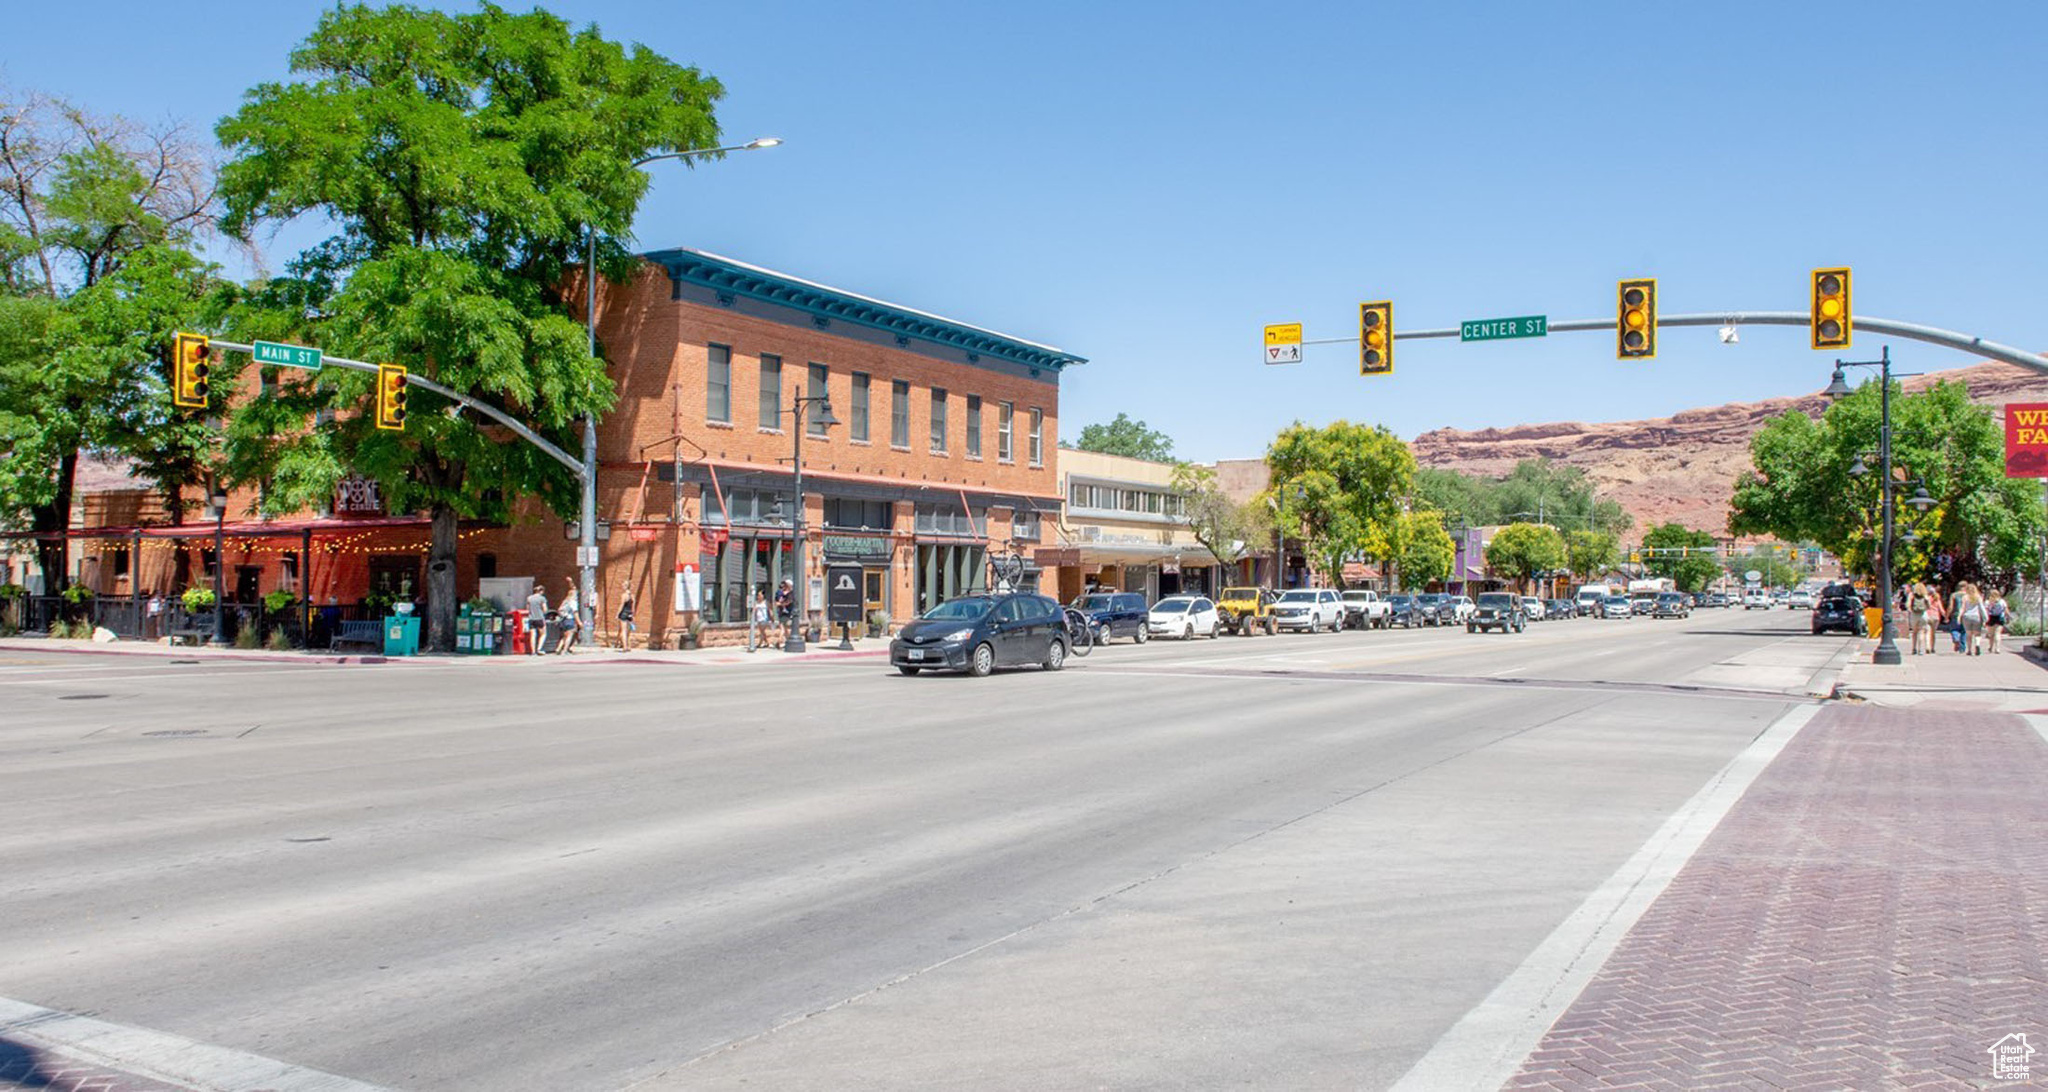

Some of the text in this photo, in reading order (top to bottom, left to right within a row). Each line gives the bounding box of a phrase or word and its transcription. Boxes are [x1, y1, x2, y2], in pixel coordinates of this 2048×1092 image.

[1463, 319, 1544, 338] CENTER ST.
[261, 346, 290, 361] MAIN
